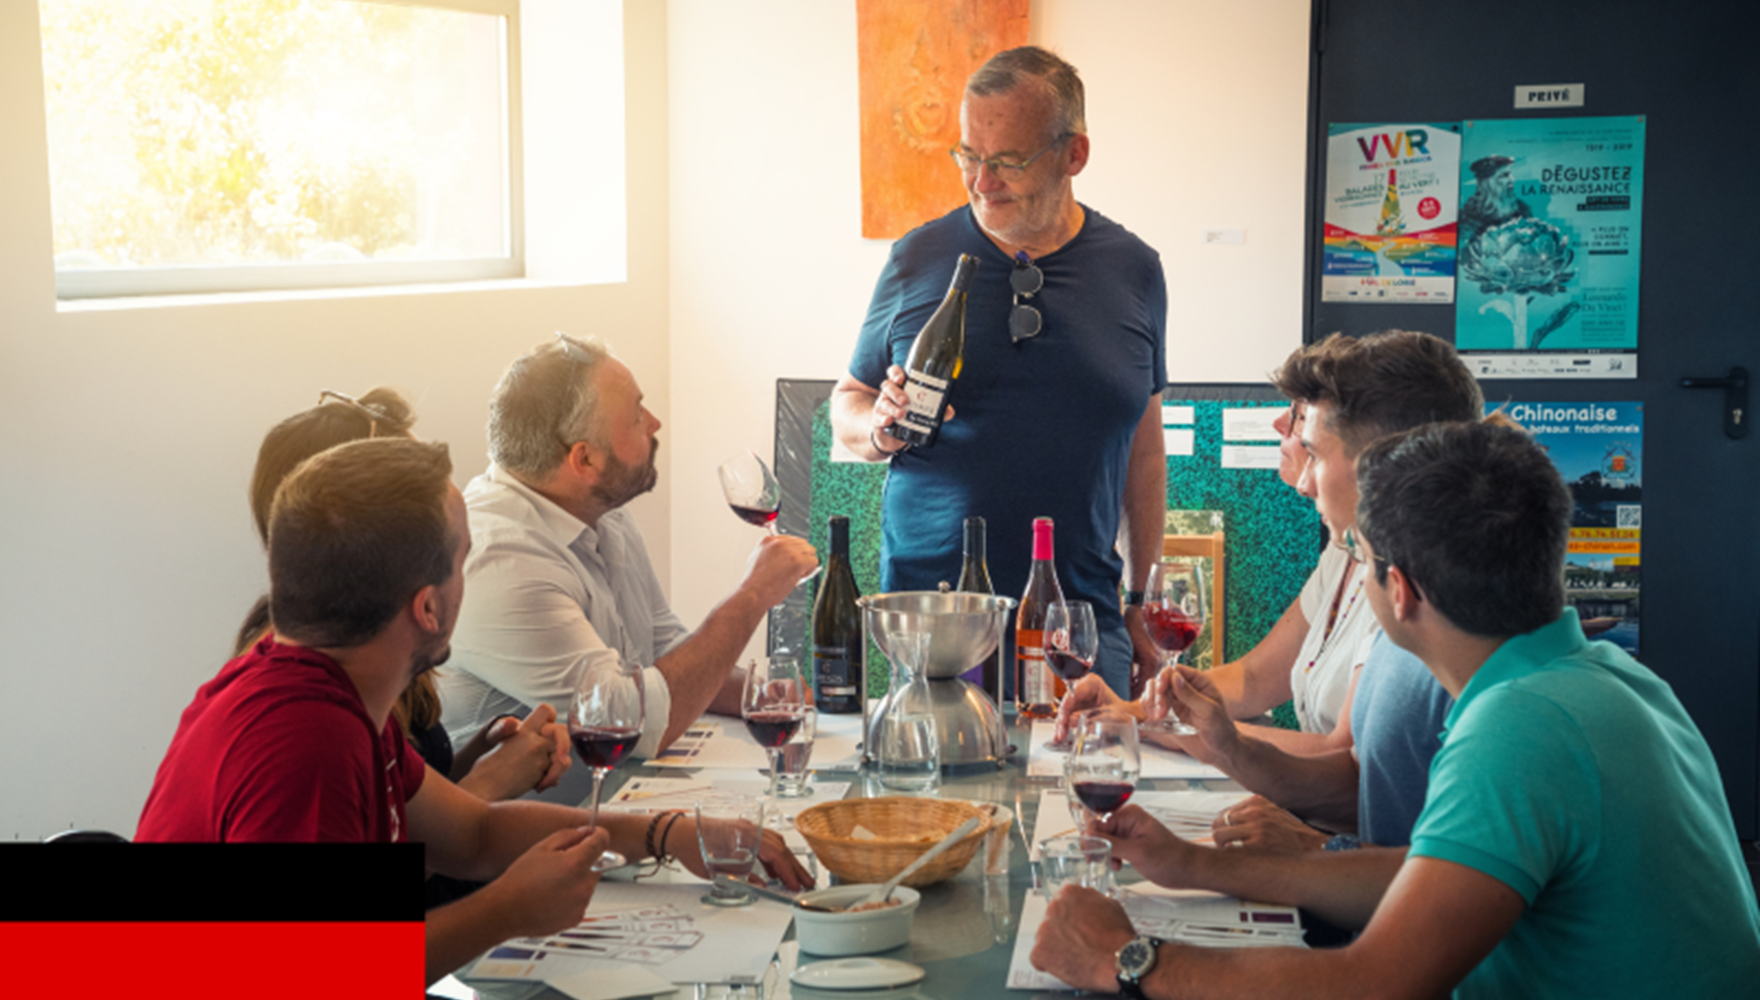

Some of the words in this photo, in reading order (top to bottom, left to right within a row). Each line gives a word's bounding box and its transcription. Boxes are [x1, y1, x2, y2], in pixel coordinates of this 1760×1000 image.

[1357, 129, 1430, 162] VVR
[1521, 184, 1537, 196] LA
[1540, 182, 1630, 196] RENAISSANCE
[1511, 404, 1617, 421] Chinonaise
[1574, 423, 1640, 434] traditionnels
